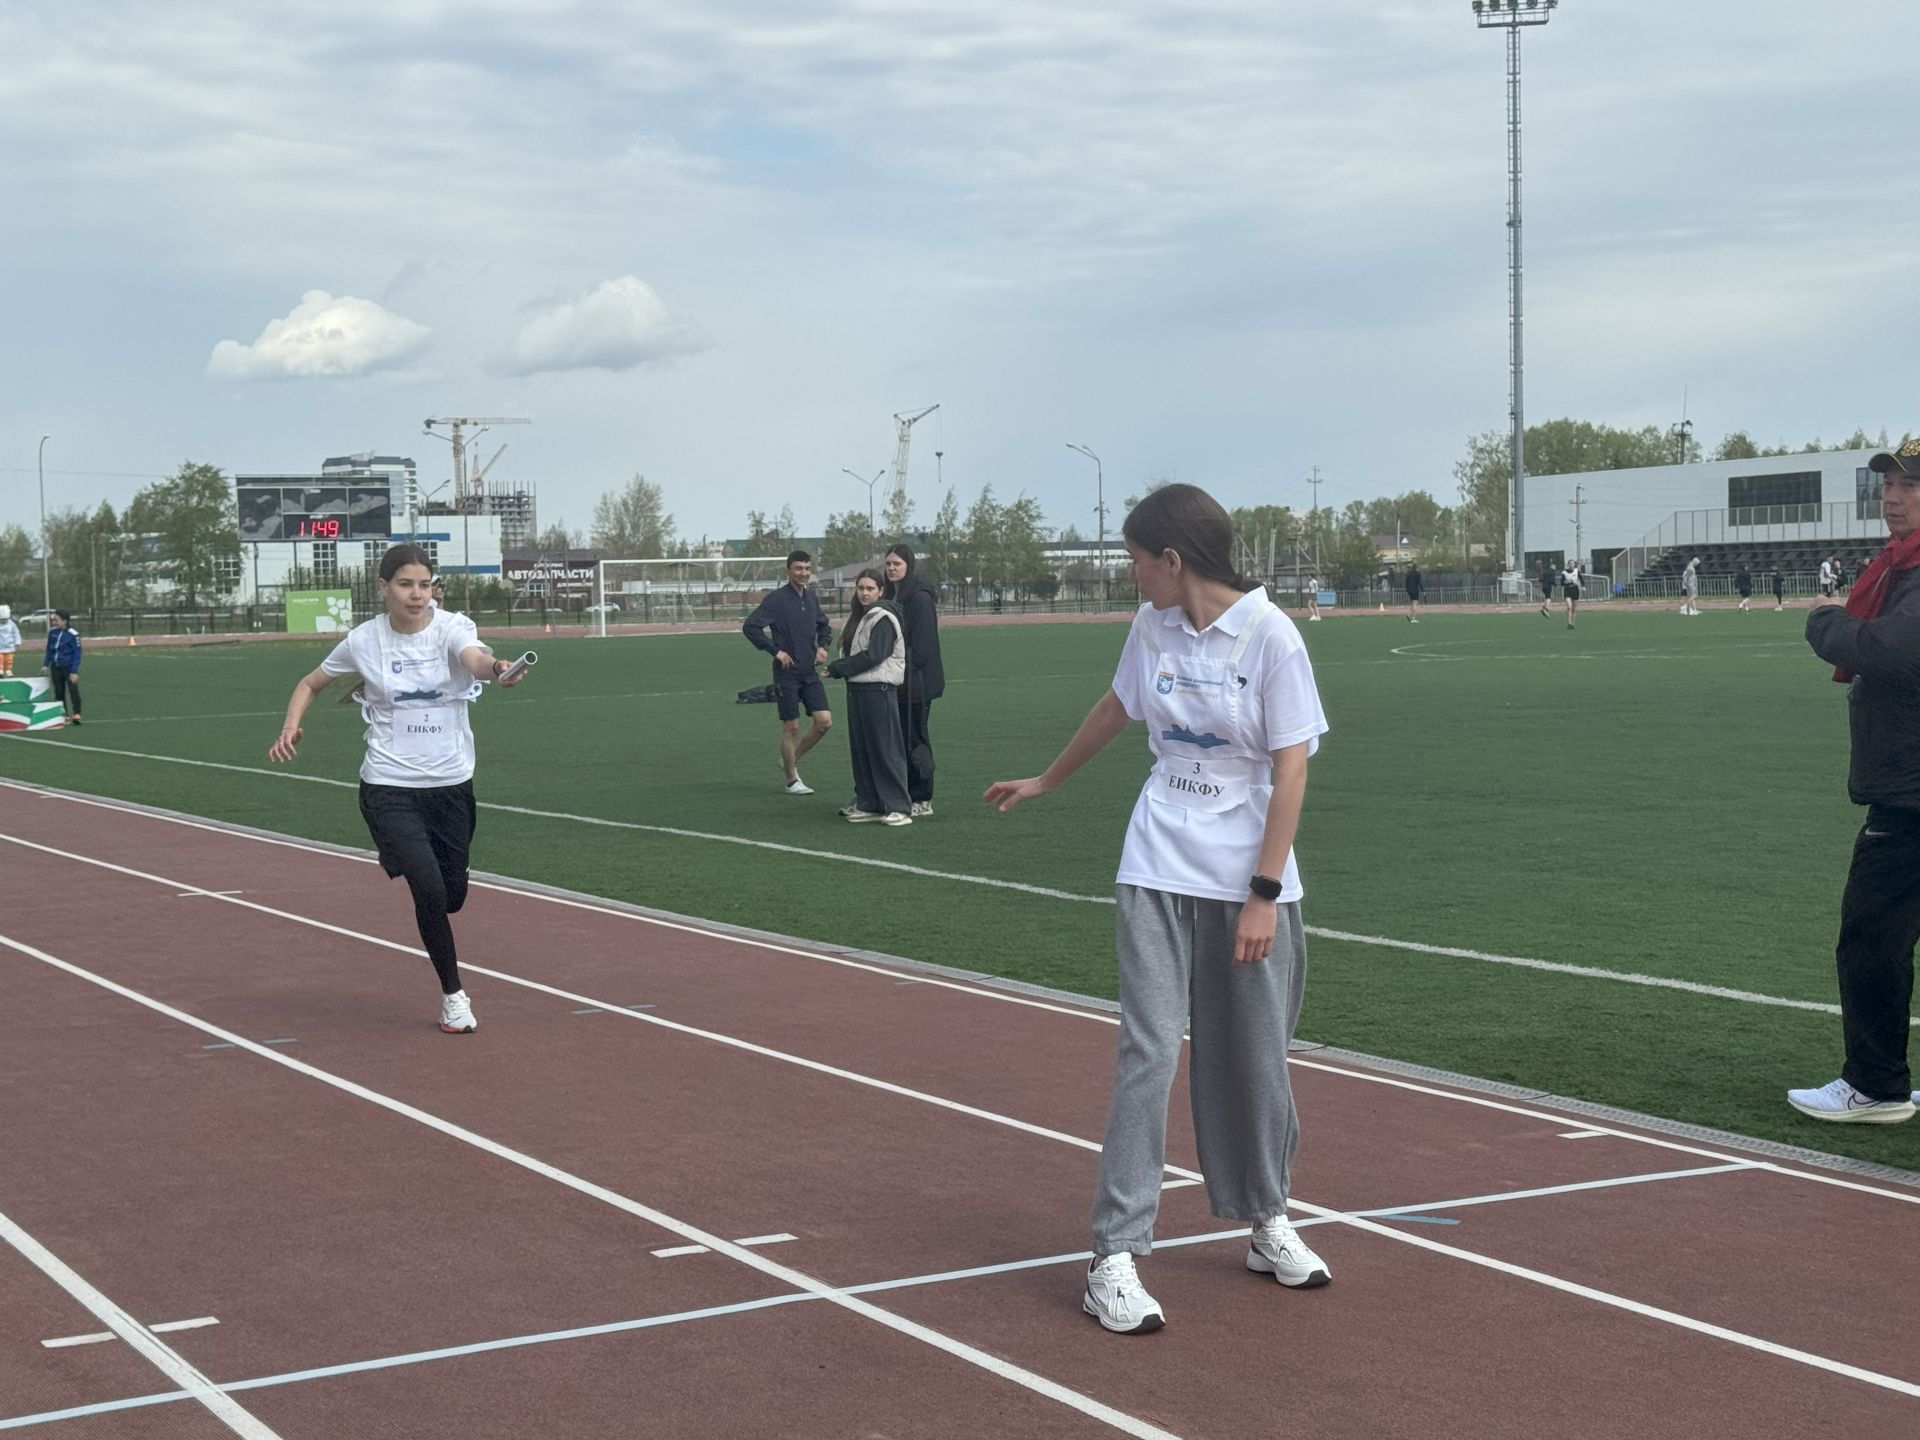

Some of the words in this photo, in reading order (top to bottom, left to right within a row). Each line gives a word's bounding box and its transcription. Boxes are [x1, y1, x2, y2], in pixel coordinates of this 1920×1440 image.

[507, 569, 594, 580] АВТОЗАПЧАСТИ
[424, 714, 429, 722] 2
[407, 724, 443, 734] ЕИКФУ
[1192, 762, 1201, 774] 3
[1169, 775, 1226, 797] ЕИКФУ
